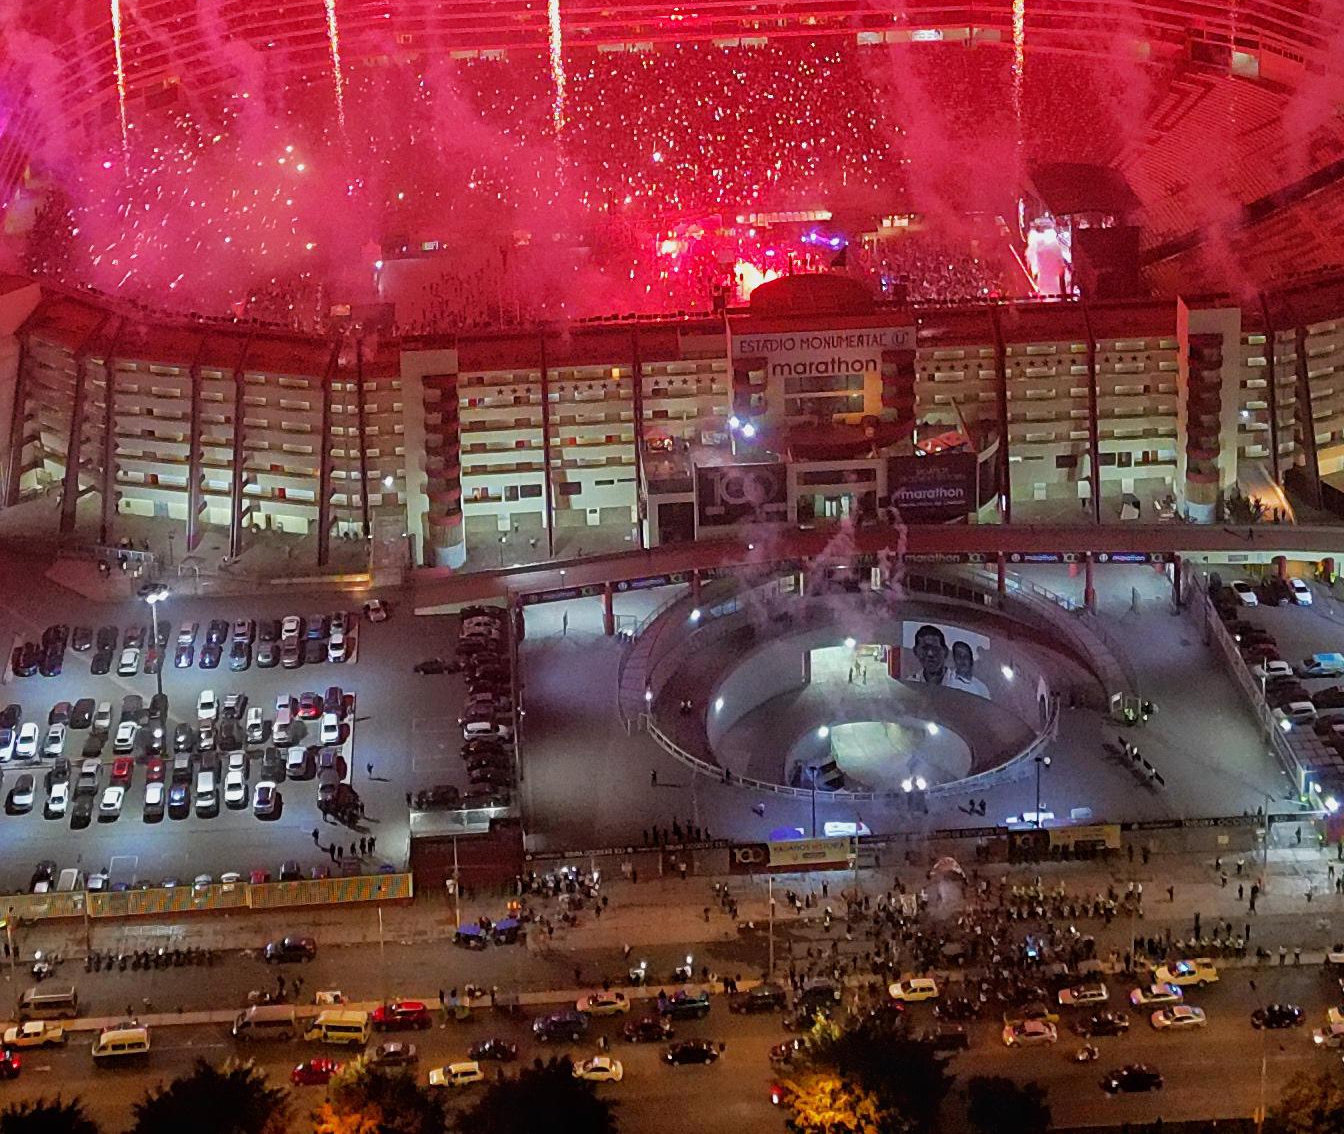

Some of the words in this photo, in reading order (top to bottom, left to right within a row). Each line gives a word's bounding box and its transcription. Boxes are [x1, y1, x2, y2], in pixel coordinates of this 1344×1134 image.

[740, 337, 795, 354] ESTADIO
[800, 333, 888, 350] MONUMENTAL
[772, 356, 877, 376] marathon
[901, 487, 964, 500] marathon
